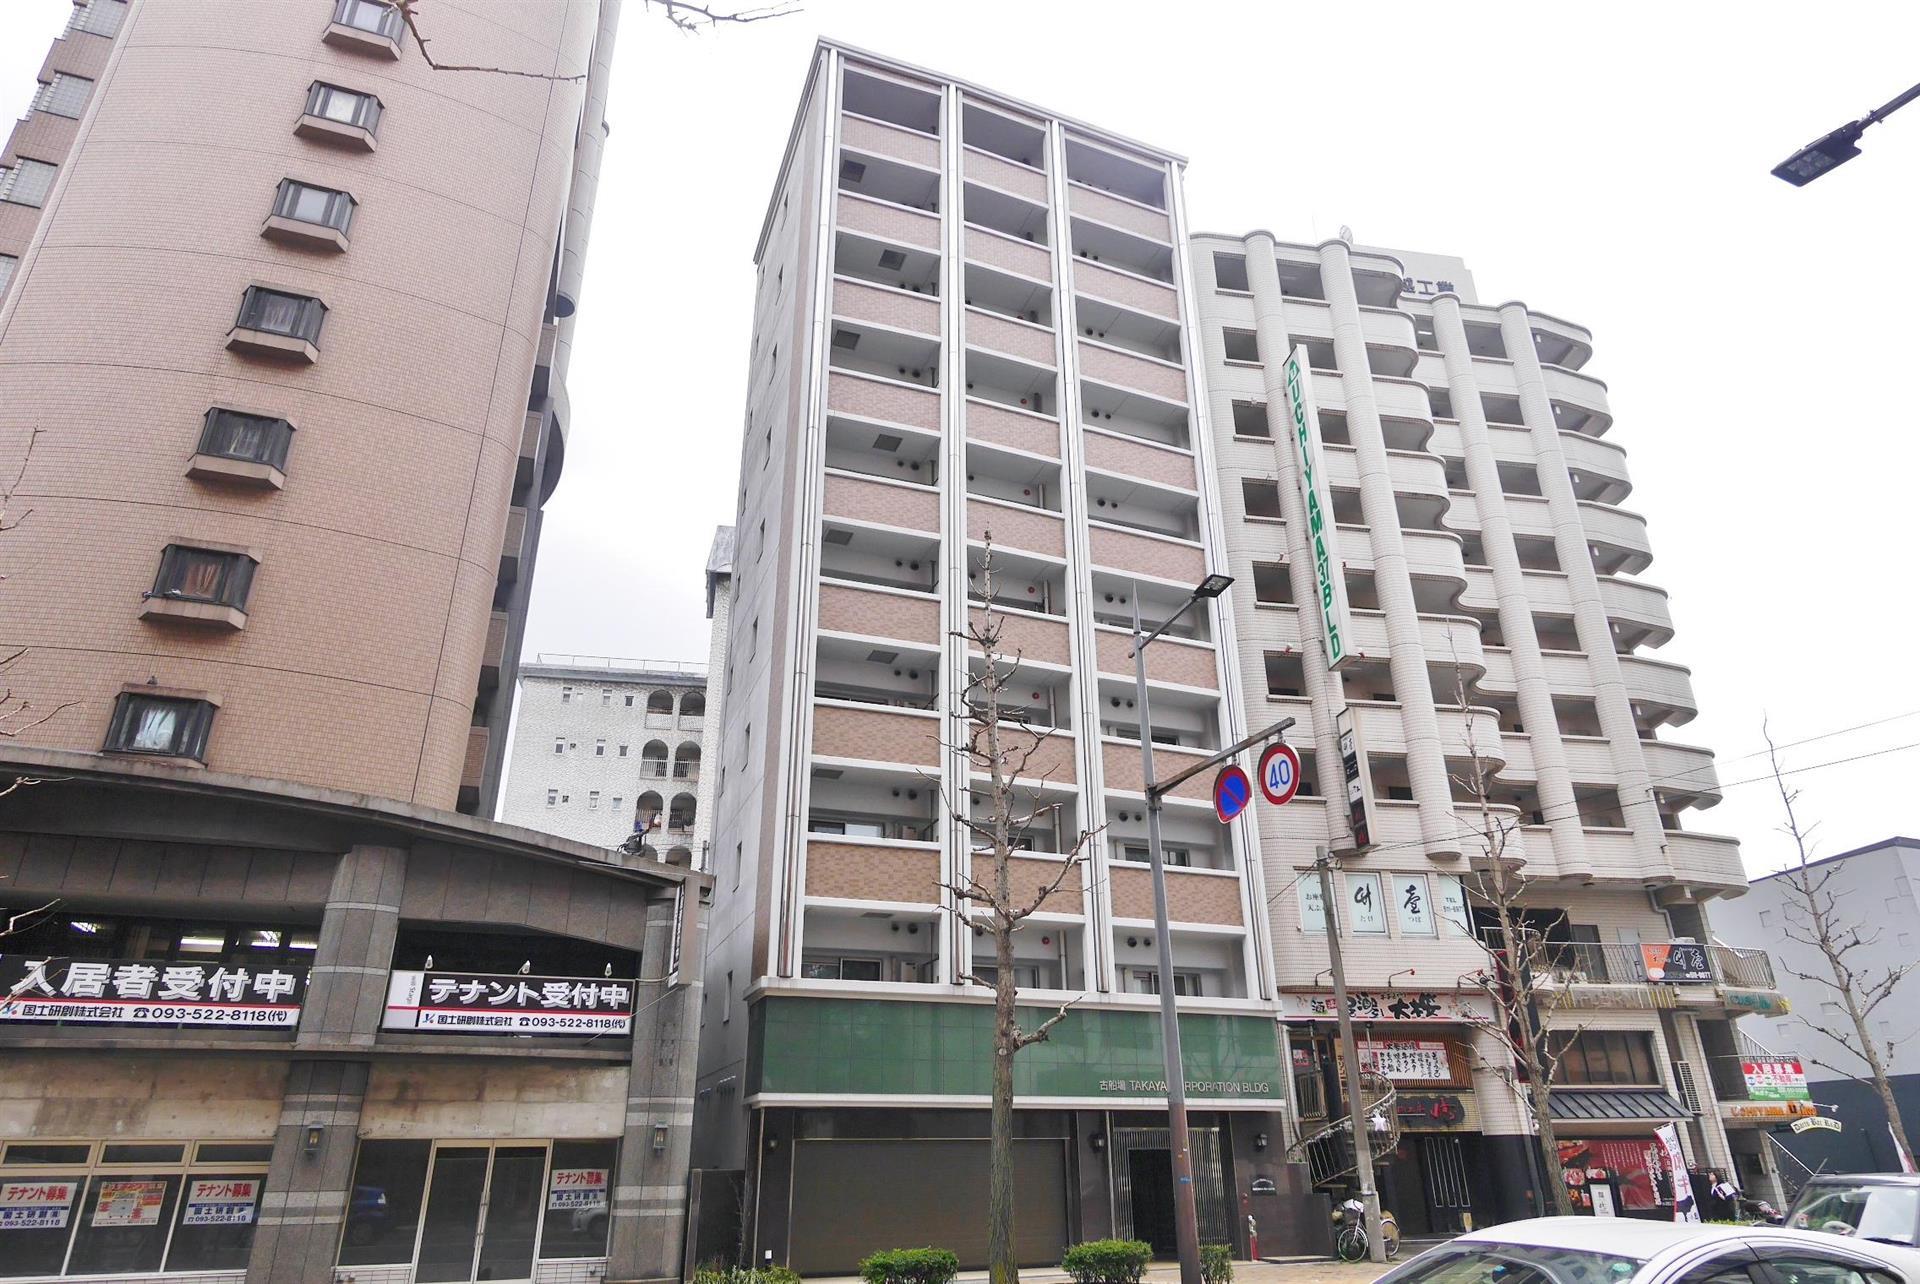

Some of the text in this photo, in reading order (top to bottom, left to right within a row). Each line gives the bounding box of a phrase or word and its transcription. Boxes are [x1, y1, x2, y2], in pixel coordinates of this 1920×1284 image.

[1270, 760, 1290, 789] 40
[10, 960, 297, 1003] 入居者受付中
[429, 977, 631, 1009] テナント受付中
[22, 1003, 125, 1019] 国土研創株式会社
[437, 1013, 513, 1027] 国土研創株式会社
[1129, 1080, 1168, 1092] TAKAYA
[1184, 1081, 1240, 1093] RPORATION
[1242, 1082, 1269, 1093] BLDG
[557, 1171, 602, 1185] テナント募集
[7, 1185, 68, 1201] テナント募集
[197, 1183, 252, 1197] テナント募集
